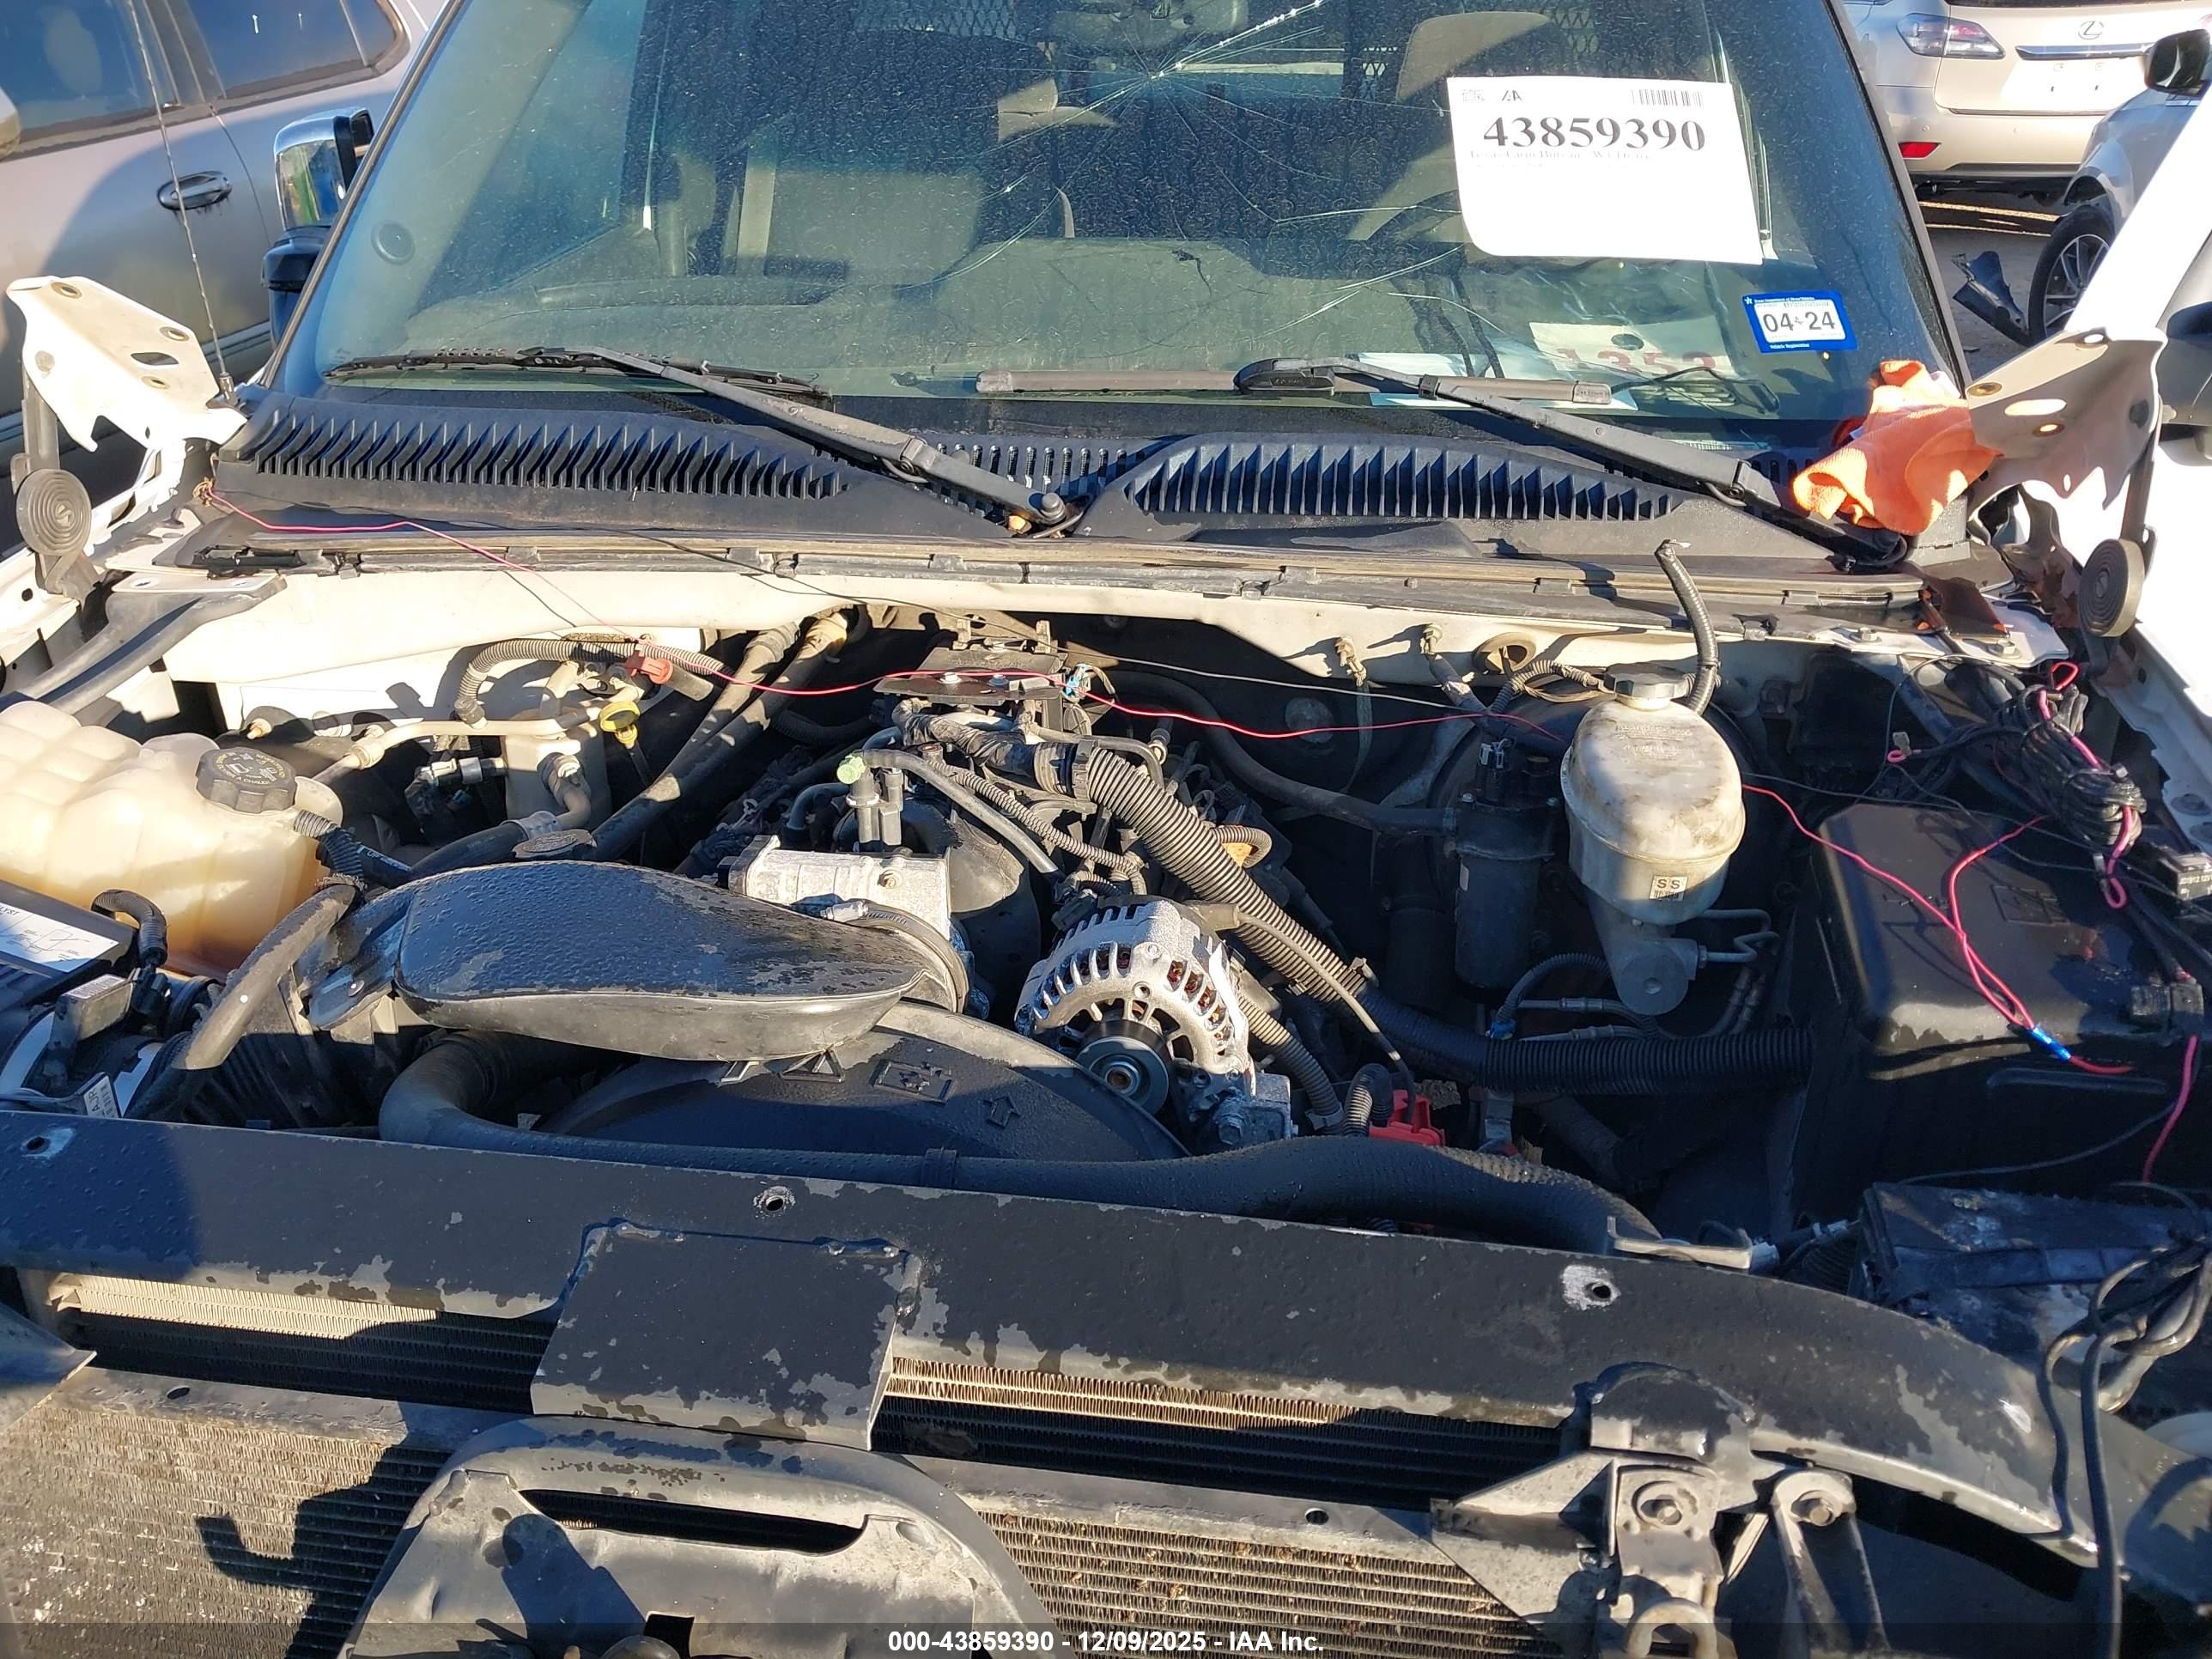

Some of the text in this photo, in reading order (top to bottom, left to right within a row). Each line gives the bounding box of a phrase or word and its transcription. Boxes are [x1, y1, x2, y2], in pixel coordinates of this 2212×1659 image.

[1483, 116, 1706, 152] 43859390
[1762, 311, 1836, 332] 04 24
